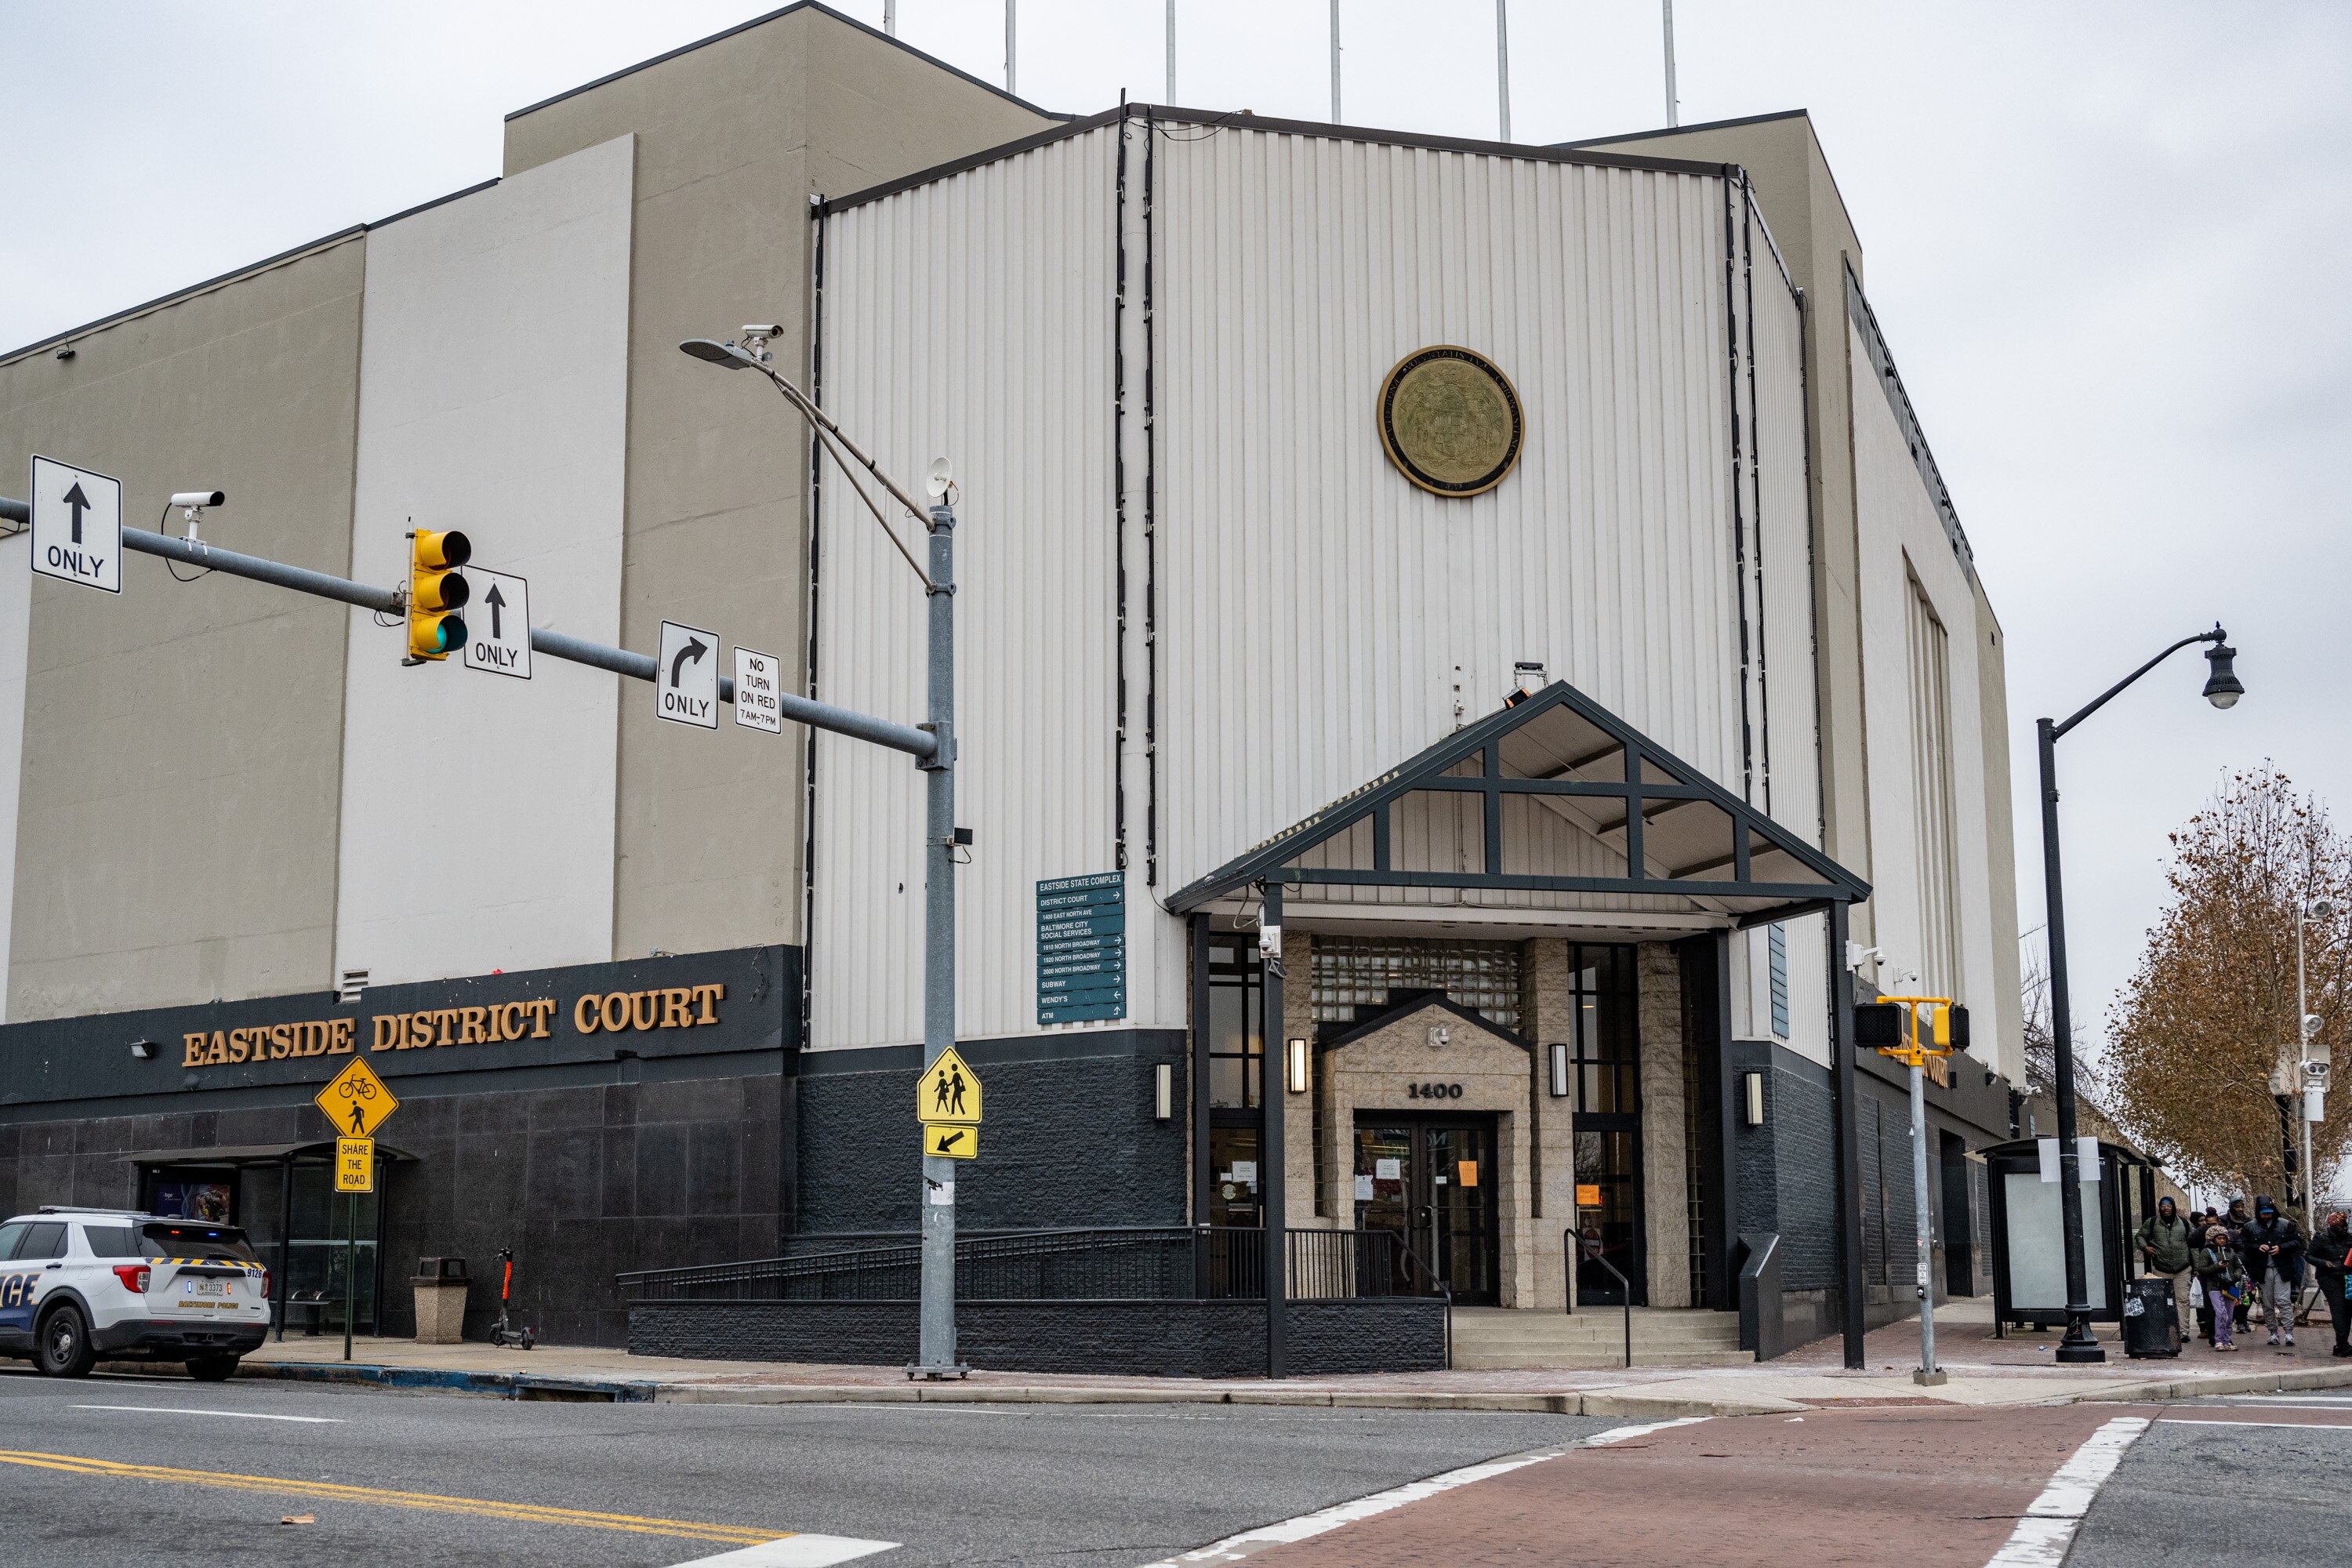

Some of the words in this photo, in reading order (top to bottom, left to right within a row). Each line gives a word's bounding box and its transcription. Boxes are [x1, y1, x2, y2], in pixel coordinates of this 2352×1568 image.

[48, 545, 104, 579] ONLY
[476, 642, 518, 668] ONLY
[750, 658, 764, 673] NO
[746, 674, 770, 691] TURN
[665, 692, 710, 718] ONLY
[741, 690, 754, 705] ON
[757, 694, 775, 710] RED
[740, 709, 776, 726] 7AM-7PM
[1040, 880, 1069, 891] EASTSIDE
[1070, 878, 1090, 887] STATE
[1091, 874, 1121, 885] COMPLEX
[1041, 897, 1066, 906] DISTRICT
[1067, 895, 1088, 903] COURT
[1041, 922, 1074, 931] BALTIMORE
[1063, 928, 1092, 937] SERVICES
[1072, 939, 1101, 948] BROADWAY
[1073, 952, 1101, 960] BROADWAY
[1041, 980, 1066, 989] SUBWAY
[182, 1018, 355, 1067] EASTSIDE
[370, 999, 557, 1052] DISTRICT
[575, 984, 724, 1033] COURT
[1409, 1083, 1463, 1099] 1400
[341, 1143, 368, 1156] SHARE
[347, 1159, 362, 1171] THE
[343, 1174, 365, 1185] ROAD
[247, 1269, 263, 1279] 9126
[209, 1283, 223, 1292] 3373
